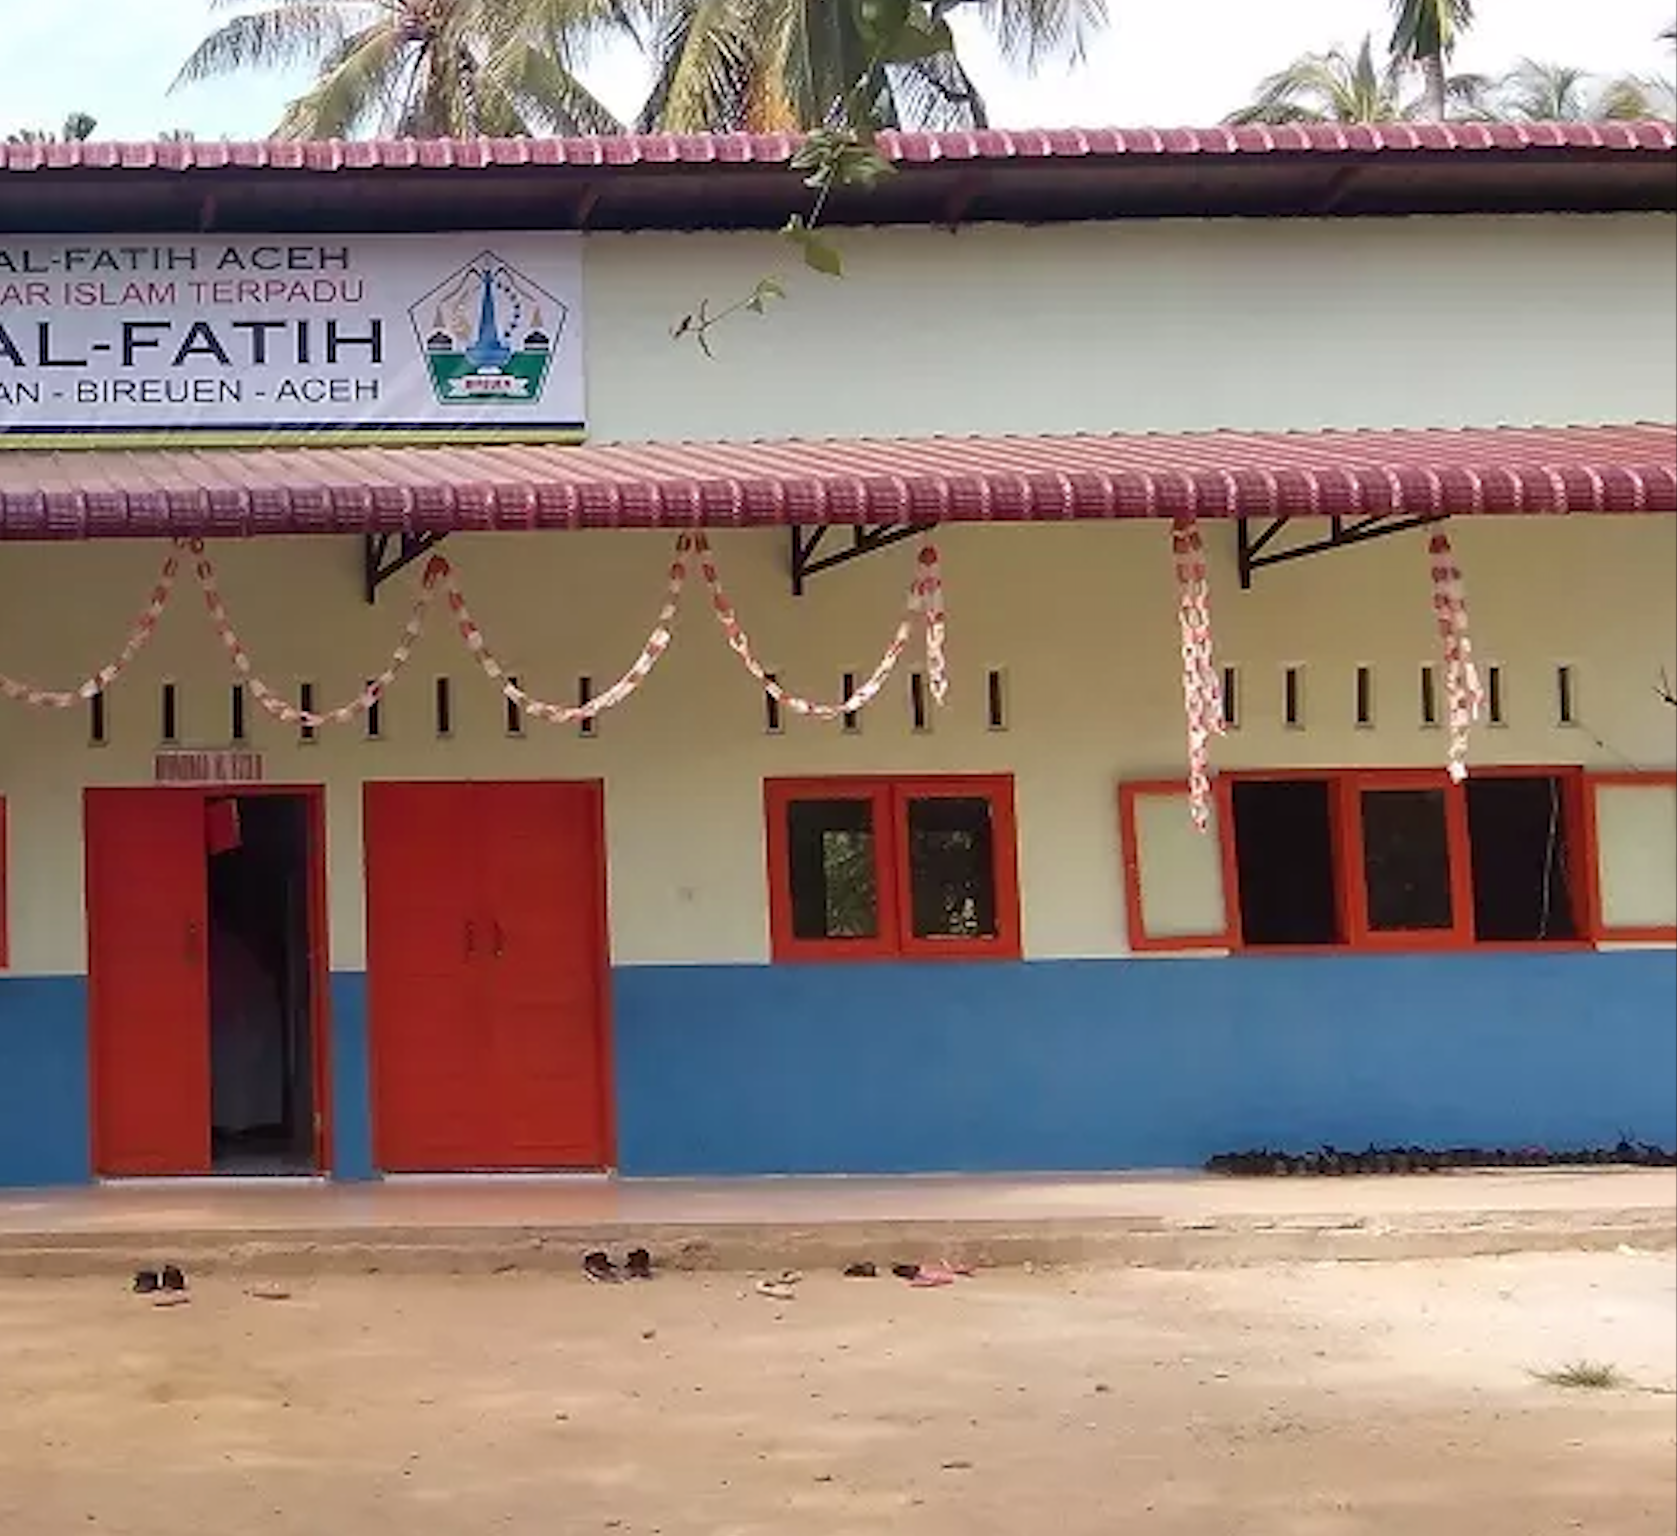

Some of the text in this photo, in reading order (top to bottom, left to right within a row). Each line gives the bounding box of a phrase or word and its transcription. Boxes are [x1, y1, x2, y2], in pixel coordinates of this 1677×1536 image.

[216, 246, 349, 271] ACEH
[64, 281, 175, 306] ISLAM
[187, 278, 364, 303] TERPADU
[77, 379, 241, 403] BIREUEN
[277, 378, 379, 401] ACEH
